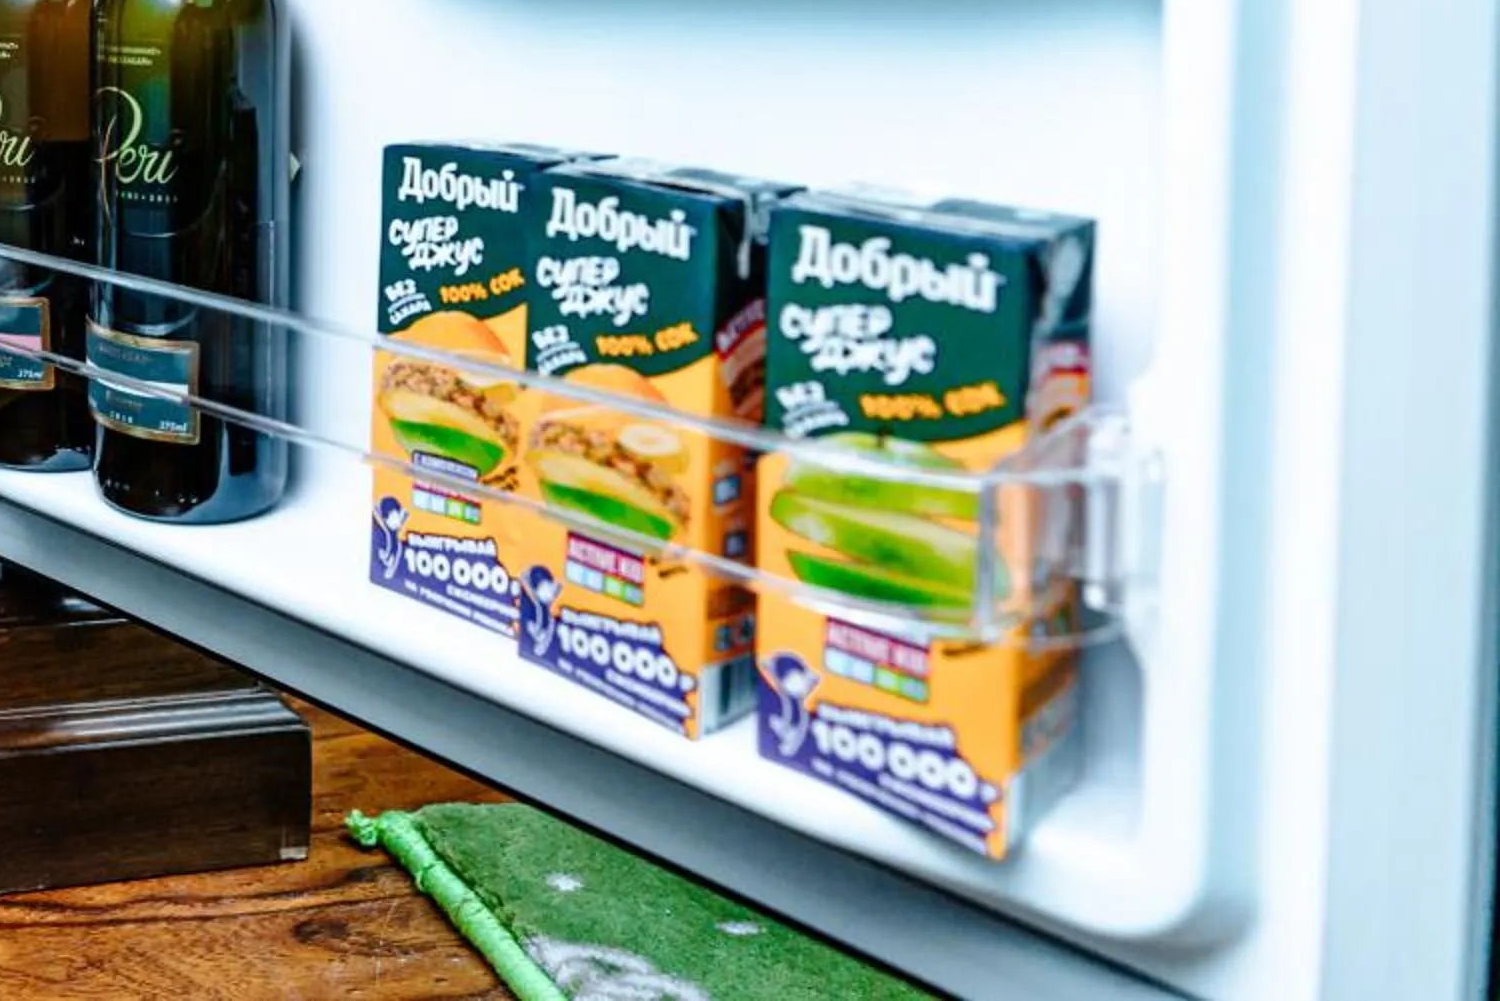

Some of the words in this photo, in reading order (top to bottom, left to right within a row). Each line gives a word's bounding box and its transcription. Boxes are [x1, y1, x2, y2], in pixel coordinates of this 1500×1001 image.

[398, 156, 518, 213] Добрый
[546, 186, 690, 261] Добрый
[439, 282, 488, 303] 100%
[489, 267, 525, 295] СОК
[791, 224, 997, 313] Добрый
[404, 547, 451, 582] 100
[452, 558, 509, 595] 000
[556, 622, 611, 666] 100
[612, 641, 678, 689] 000
[811, 719, 885, 771] 100
[887, 741, 978, 799] 000
